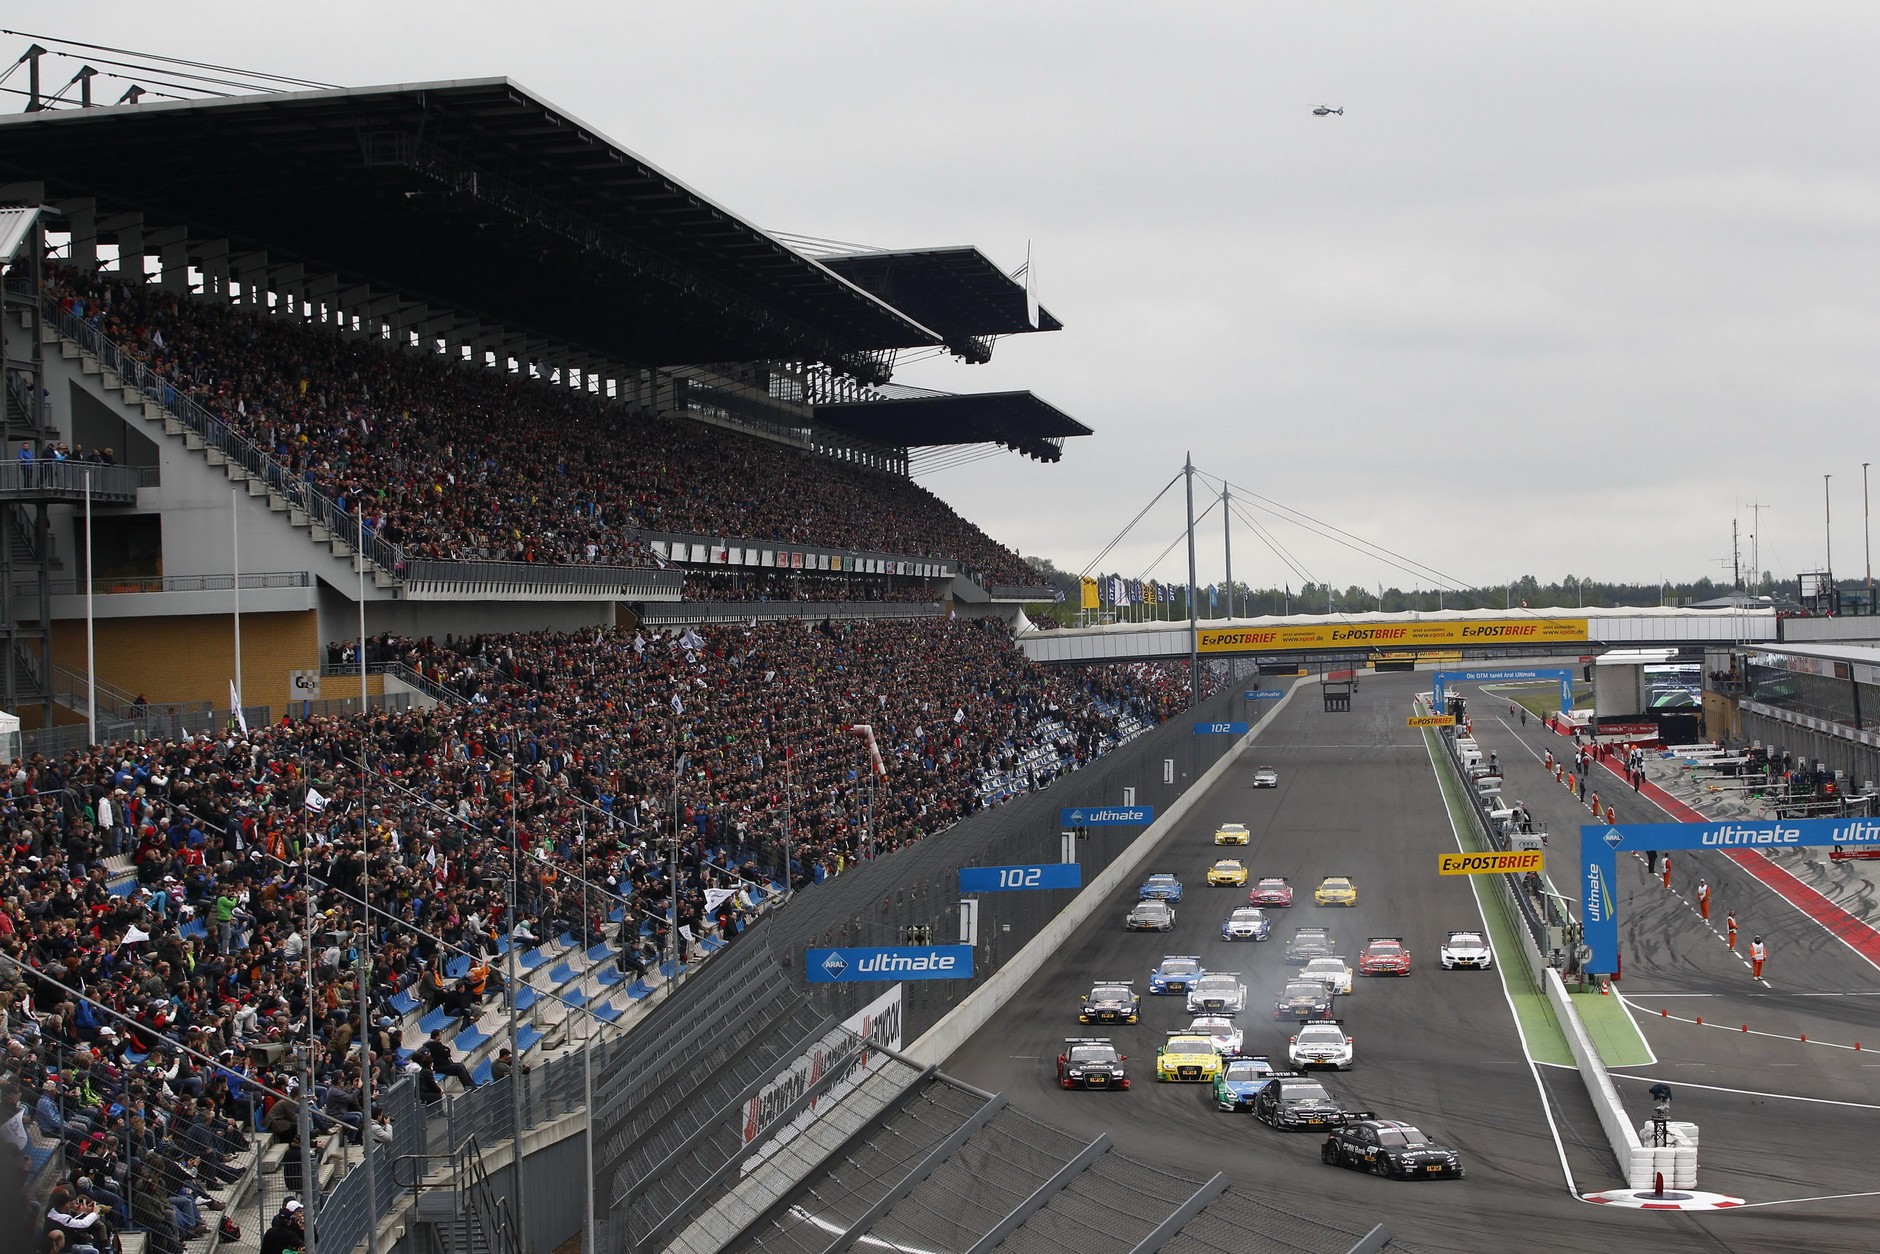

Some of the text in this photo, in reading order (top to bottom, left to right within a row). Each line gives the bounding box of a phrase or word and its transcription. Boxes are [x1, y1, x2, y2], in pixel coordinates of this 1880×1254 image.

[1211, 723, 1231, 733] 102
[1090, 810, 1144, 821] ultimate
[1702, 825, 1800, 845] ultimate
[1000, 868, 1042, 888] 102
[1588, 863, 1600, 922] ultimate
[858, 952, 956, 972] ultimate
